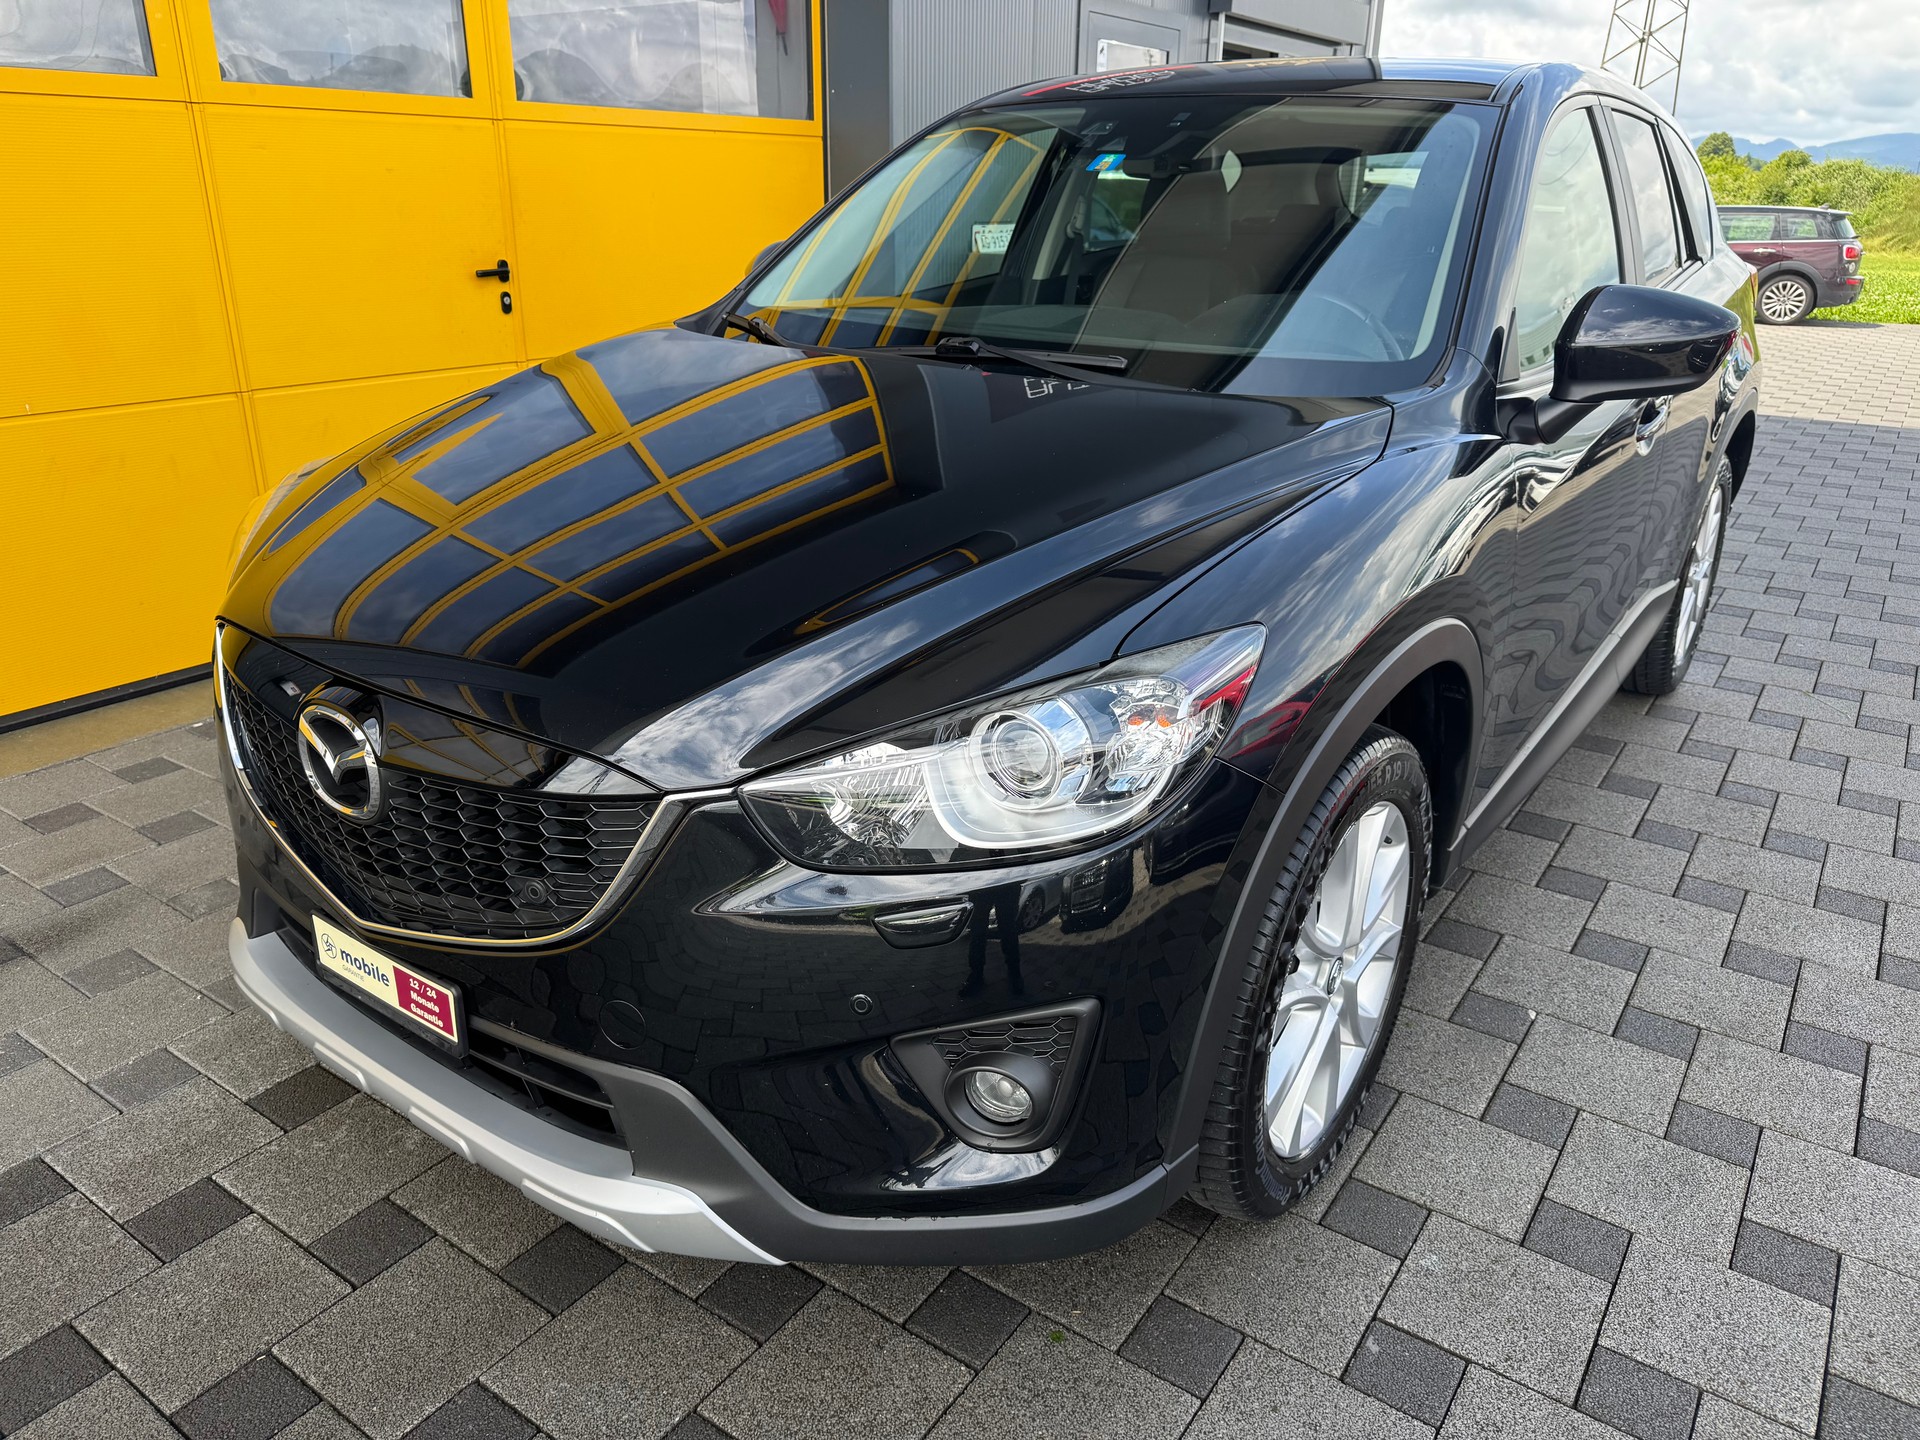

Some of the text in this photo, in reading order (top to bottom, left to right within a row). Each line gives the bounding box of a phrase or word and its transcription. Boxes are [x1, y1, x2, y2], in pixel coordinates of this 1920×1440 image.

[340, 948, 389, 987] mobile
[409, 978, 420, 990] 12
[426, 987, 437, 1000] 24
[410, 990, 440, 1013] Monate
[410, 1003, 444, 1027] Garantie
[1253, 1100, 1291, 1206] PremiumContact
